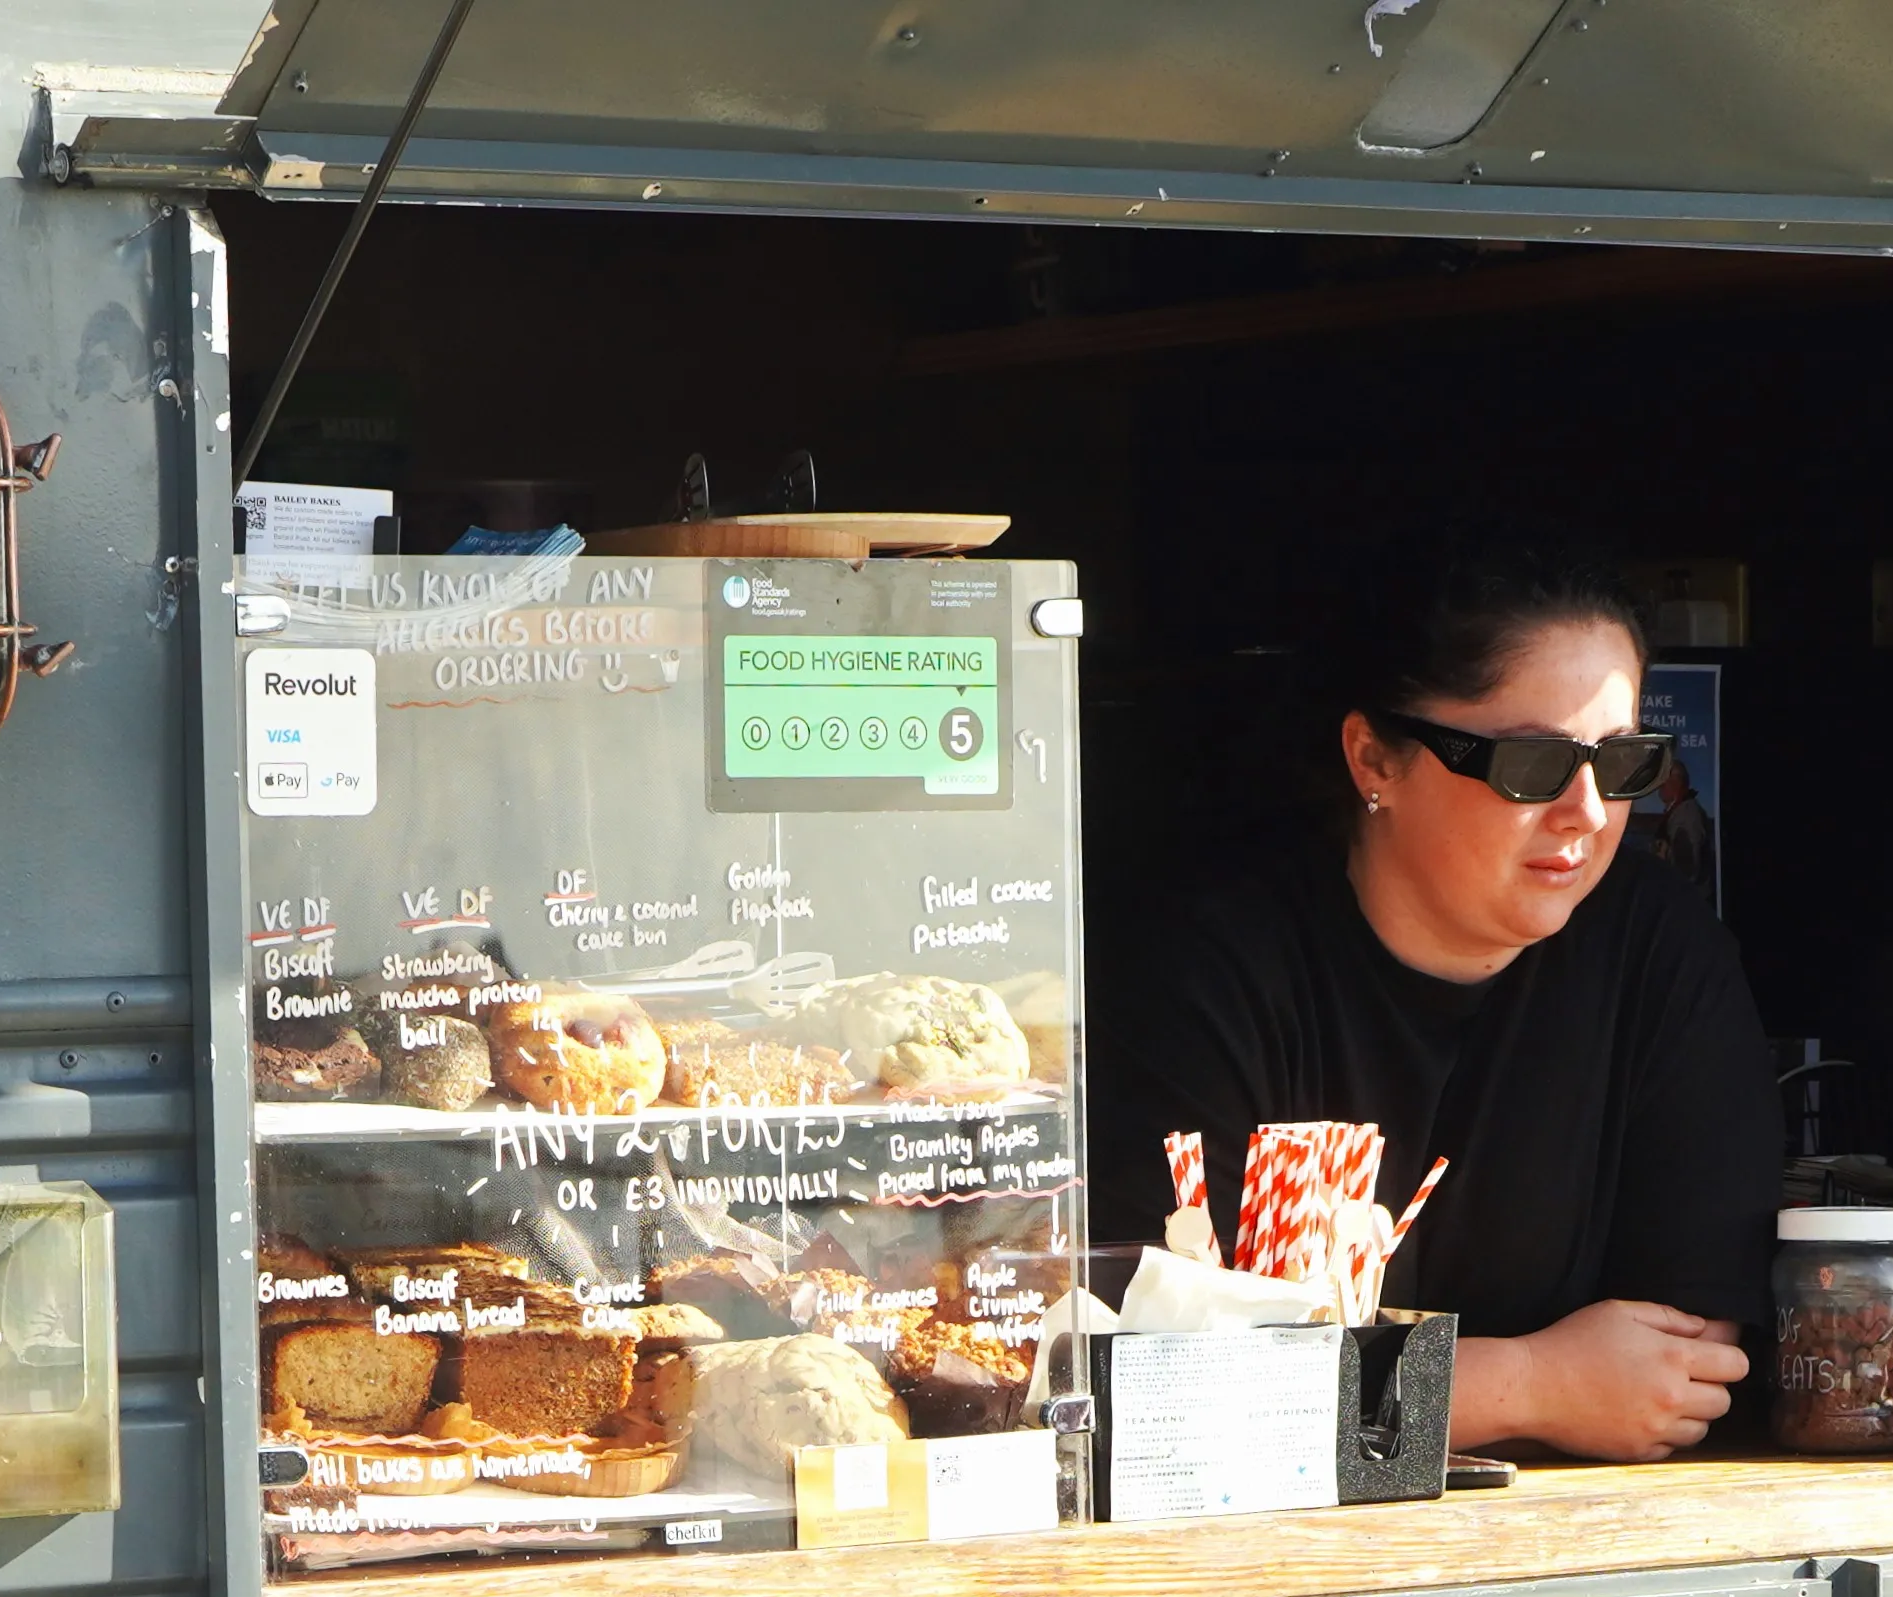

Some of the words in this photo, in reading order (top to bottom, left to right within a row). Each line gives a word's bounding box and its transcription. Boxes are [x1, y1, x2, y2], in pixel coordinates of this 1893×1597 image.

[273, 494, 309, 506] BAILEY
[309, 495, 341, 507] BAKES
[370, 567, 407, 609] US
[590, 564, 655, 603] ANY
[376, 610, 530, 656] ALLERGIES
[542, 609, 656, 646] BEFORE
[434, 649, 587, 692] ORDERING
[739, 650, 805, 672] FOOD
[811, 650, 902, 672] HYGIENE
[907, 650, 983, 673] RATING
[264, 672, 357, 697] Revolut
[266, 729, 302, 745] VISA
[750, 723, 762, 743] 0
[790, 723, 800, 742] 1
[829, 723, 840, 742] 2
[868, 723, 880, 743] 3
[907, 722, 919, 742] 4
[950, 714, 973, 754] 5
[1680, 733, 1708, 748] SEA
[557, 869, 587, 895] DF
[261, 900, 292, 934] VE
[302, 897, 332, 927] DF
[402, 888, 441, 922] VE
[460, 886, 493, 917] DF
[264, 938, 335, 982] Biscoff
[266, 985, 354, 1022] Brownie
[380, 985, 462, 1012] matcha
[468, 974, 543, 1015] protein
[400, 1014, 447, 1050] ball
[889, 1132, 973, 1167] Bramley
[981, 1124, 1040, 1157] Apples
[557, 1180, 598, 1212] OR
[625, 1178, 666, 1212] £3
[677, 1167, 840, 1207] INDIVIDUALLY
[257, 1271, 349, 1303] Brownies
[392, 1268, 460, 1307] Biscoff
[574, 1276, 646, 1305] Carrot
[375, 1305, 462, 1337] Banana
[465, 1297, 527, 1331] bread
[1124, 1415, 1148, 1425] TEA
[1152, 1413, 1187, 1424] MENU
[311, 1454, 347, 1487] All
[356, 1452, 423, 1486] bakes
[666, 1523, 719, 1543] chefkit
